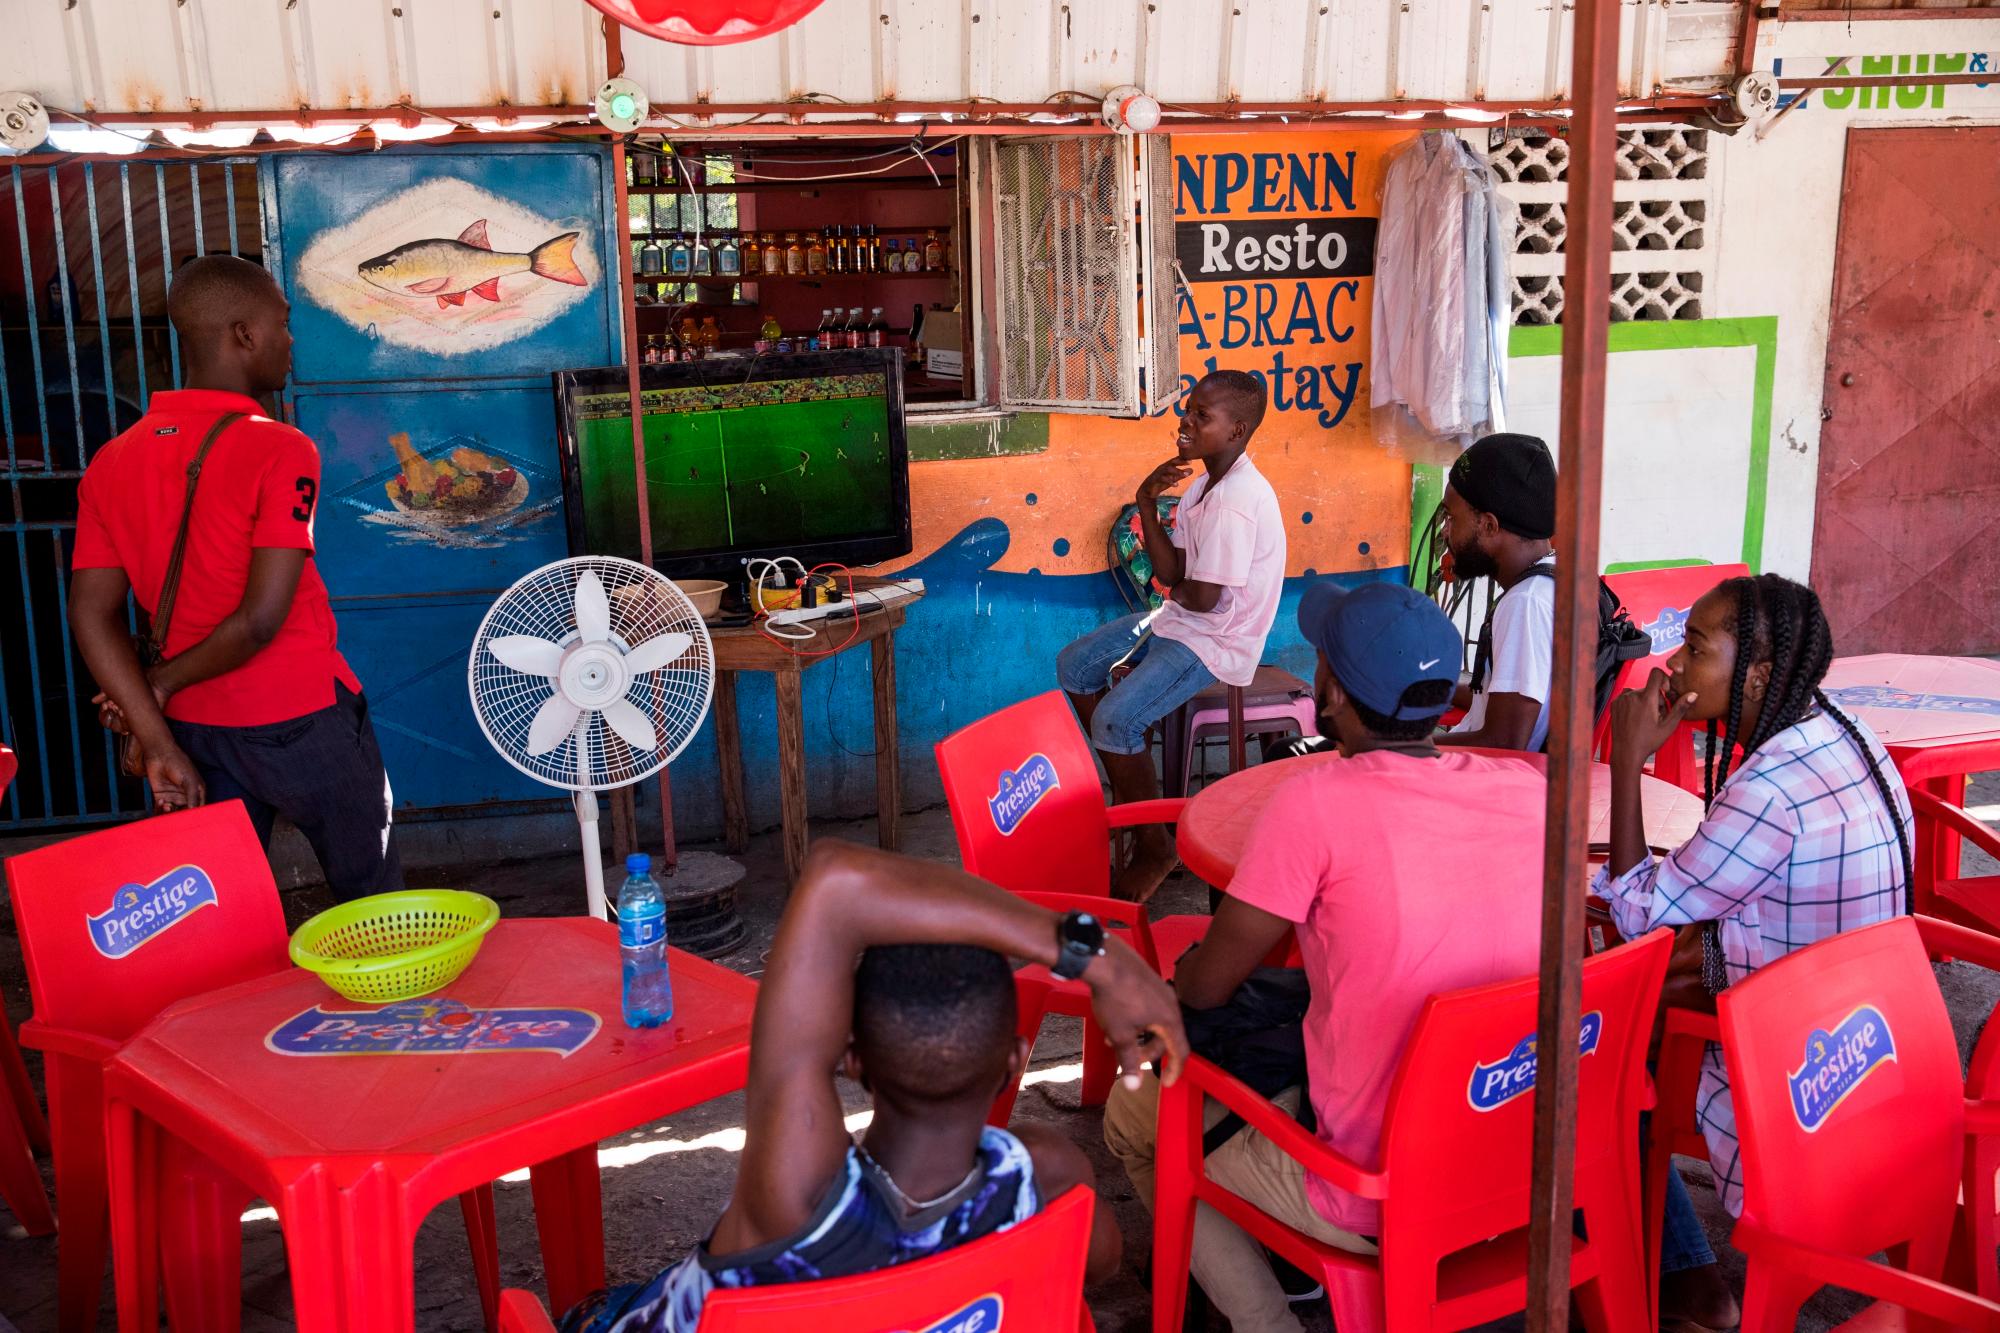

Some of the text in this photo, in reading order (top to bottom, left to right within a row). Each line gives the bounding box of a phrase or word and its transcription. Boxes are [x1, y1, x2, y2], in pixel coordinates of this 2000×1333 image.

[1200, 222, 1348, 273] Resto
[293, 476, 316, 522] 3
[996, 764, 1047, 825] Prestige
[103, 876, 198, 948] Prestige
[1799, 1022, 1877, 1117] Prestige
